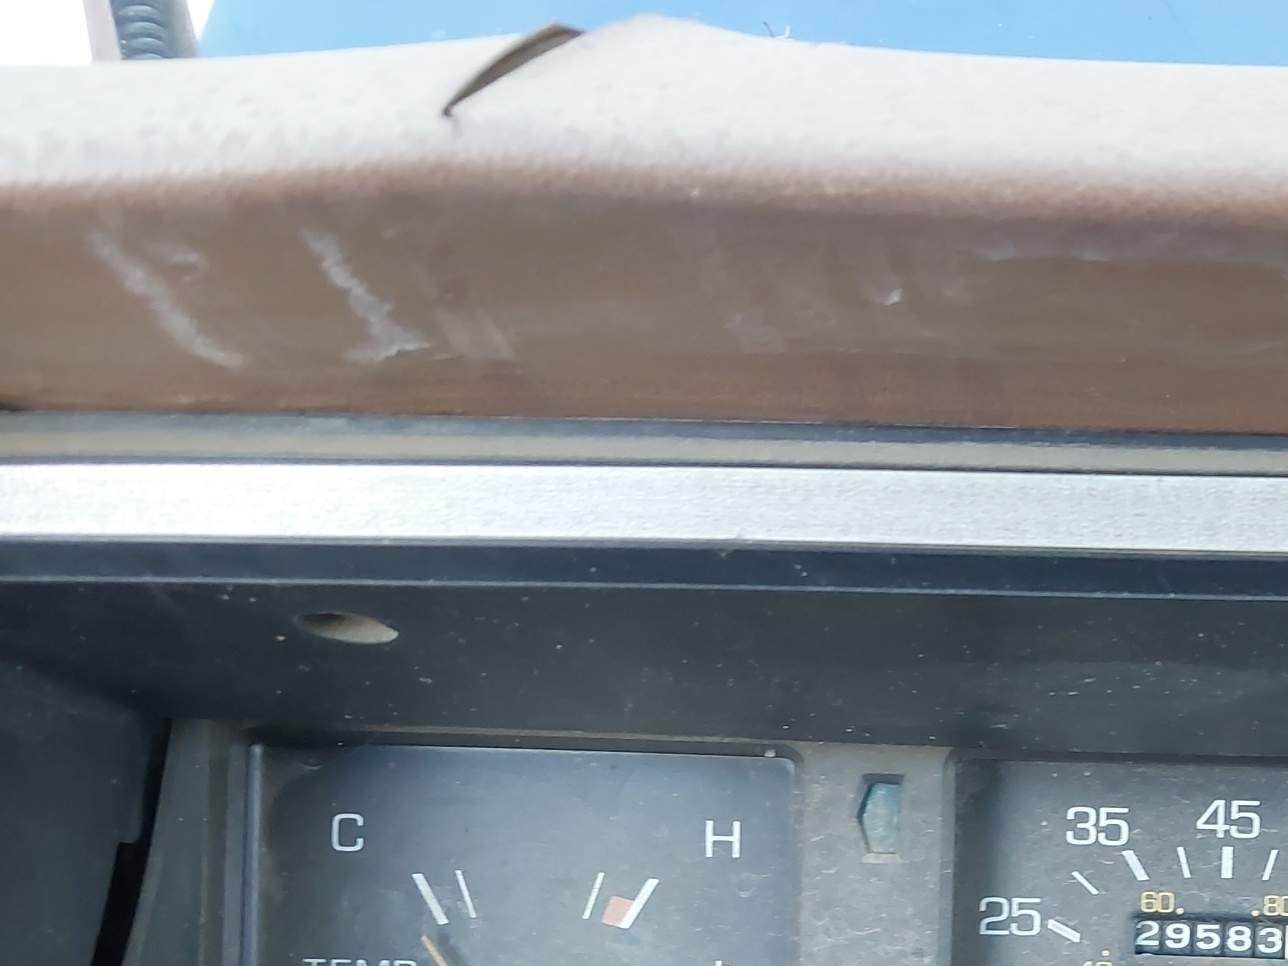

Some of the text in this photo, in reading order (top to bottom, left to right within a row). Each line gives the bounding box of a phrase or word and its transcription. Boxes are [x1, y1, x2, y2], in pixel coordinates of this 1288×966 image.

[331, 813, 365, 853] C
[704, 820, 742, 858] H
[1064, 806, 1131, 846] 35
[1195, 799, 1262, 840] 45
[978, 897, 1042, 937] 25
[1140, 891, 1176, 914] 60
